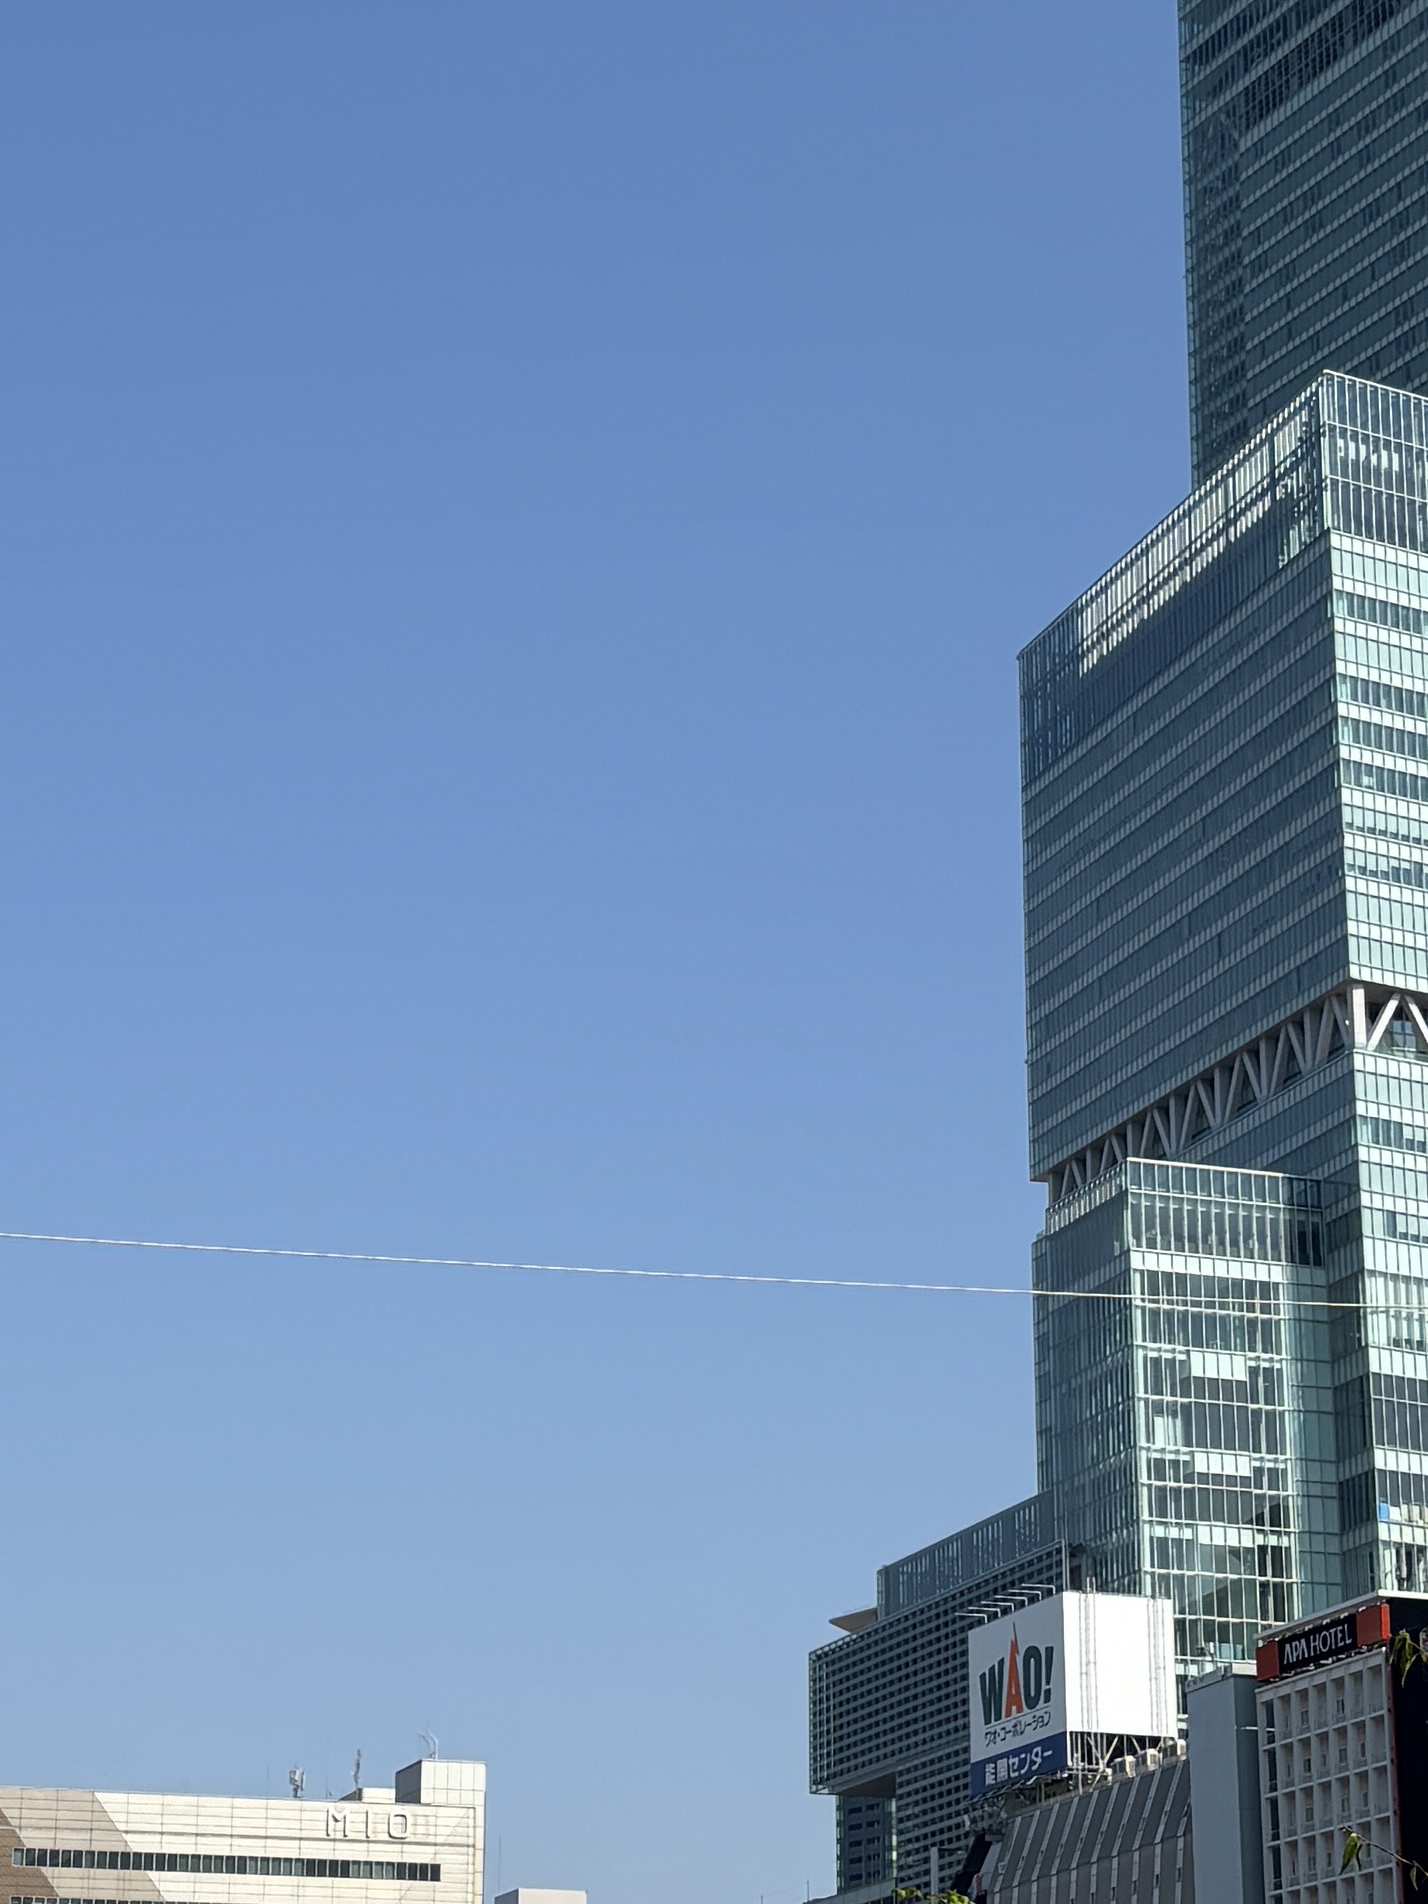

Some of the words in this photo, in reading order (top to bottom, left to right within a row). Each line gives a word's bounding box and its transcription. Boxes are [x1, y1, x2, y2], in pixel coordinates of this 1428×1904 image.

[1283, 1638, 1308, 1664] APA
[1310, 1624, 1352, 1656] HOTEL
[979, 1622, 1054, 1726] WAO!
[985, 1746, 1053, 1786] 能開センター
[326, 1806, 411, 1840] MIO
